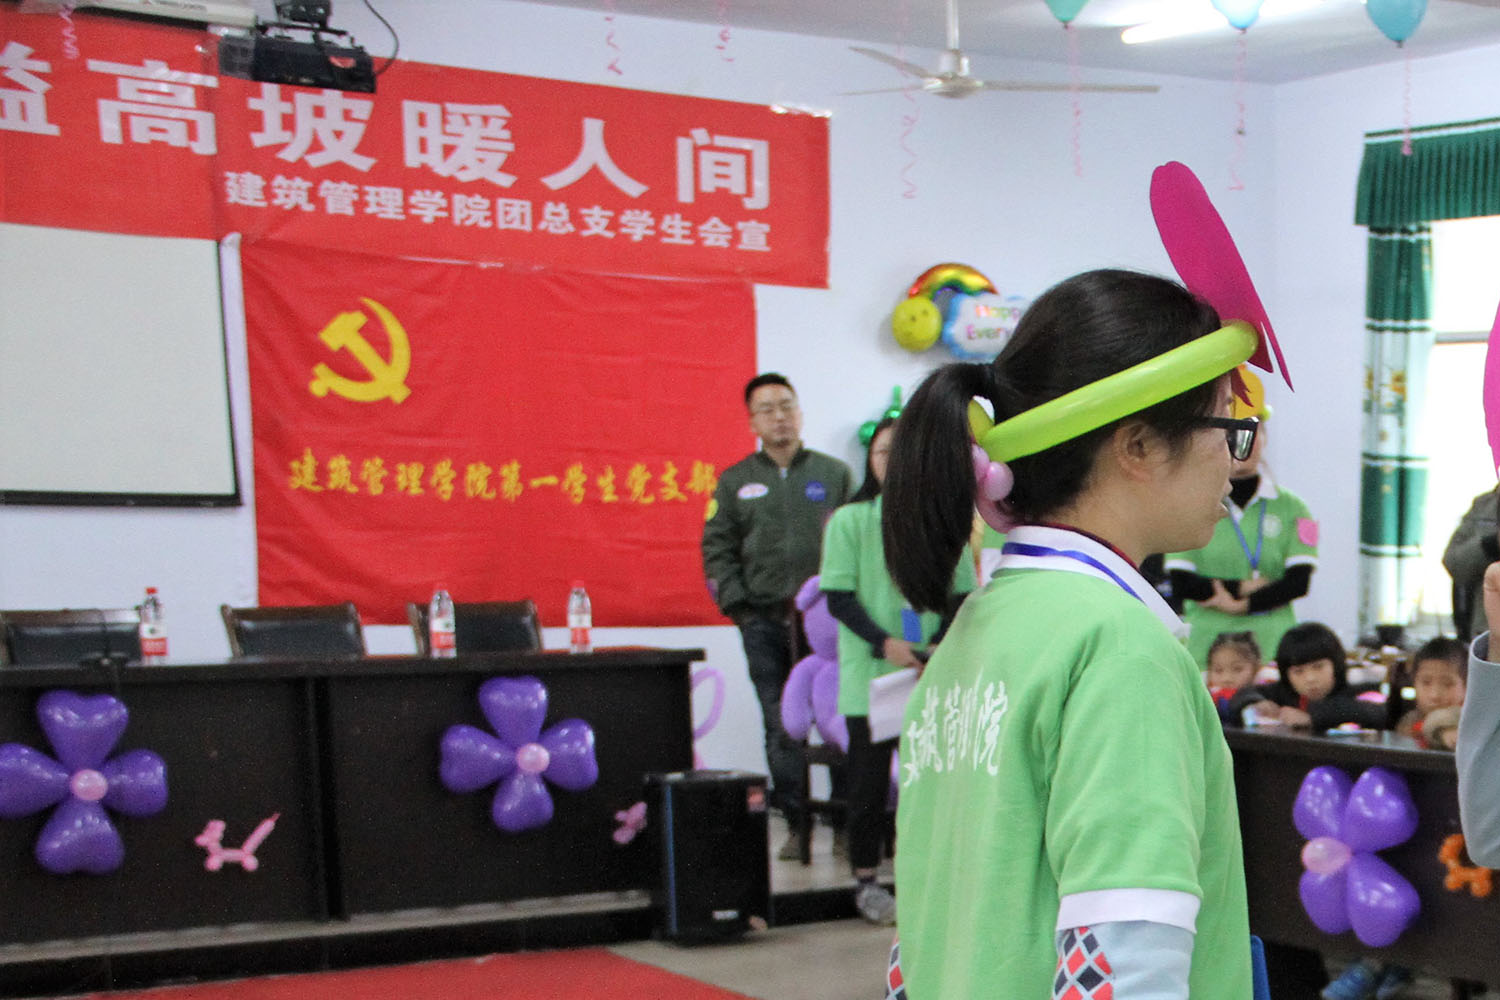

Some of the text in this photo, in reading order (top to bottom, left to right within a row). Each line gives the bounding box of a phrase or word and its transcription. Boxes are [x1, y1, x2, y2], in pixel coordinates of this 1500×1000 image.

[225, 171, 771, 252] 建筑管理学院团总支学生会宣
[289, 447, 718, 504] 建筑管理学院第一学生党支部
